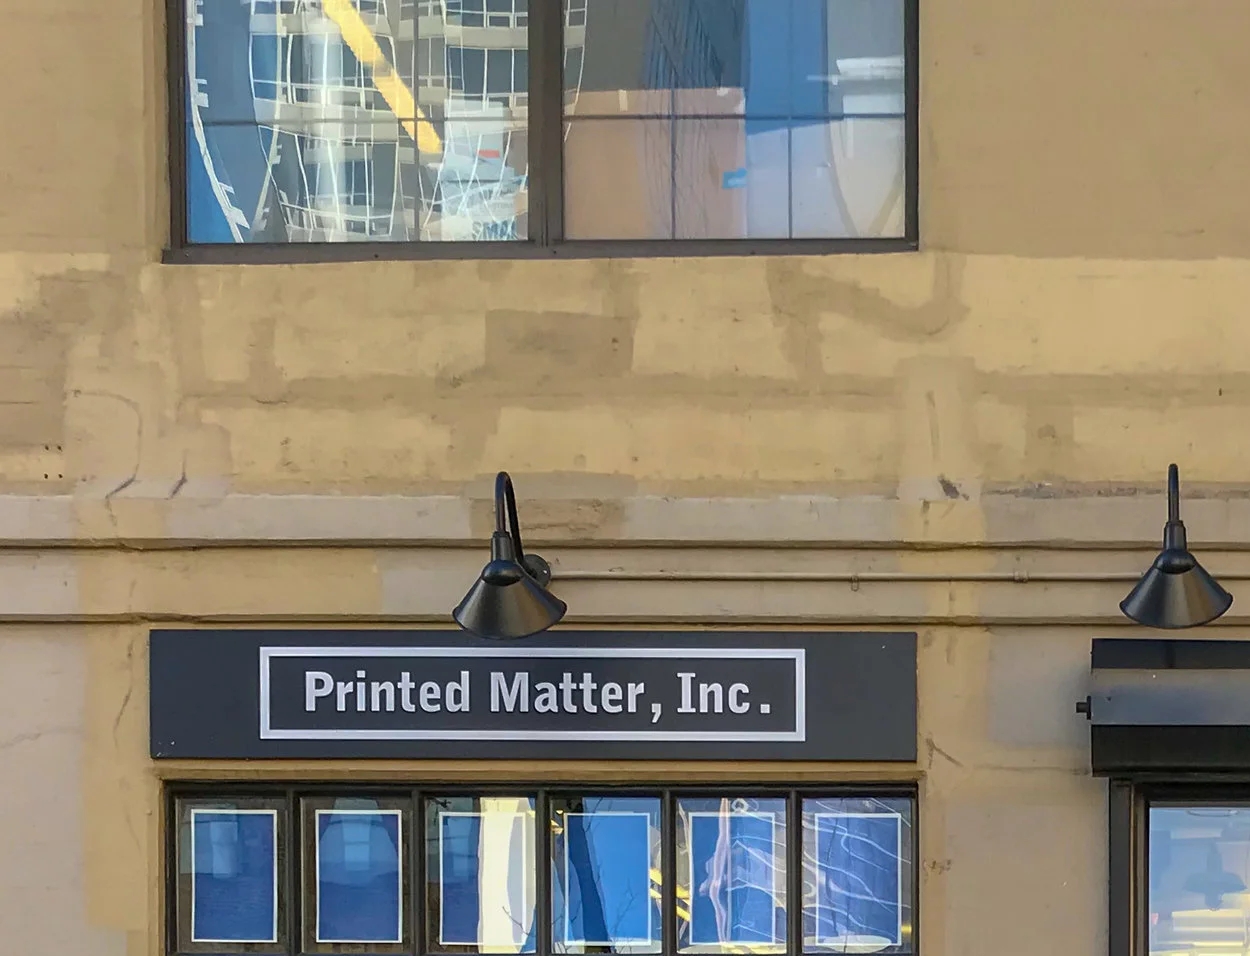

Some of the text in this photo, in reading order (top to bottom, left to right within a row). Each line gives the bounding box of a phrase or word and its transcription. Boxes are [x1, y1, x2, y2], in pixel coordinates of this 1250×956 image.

[305, 670, 771, 724] Printed Matter, Inc.
